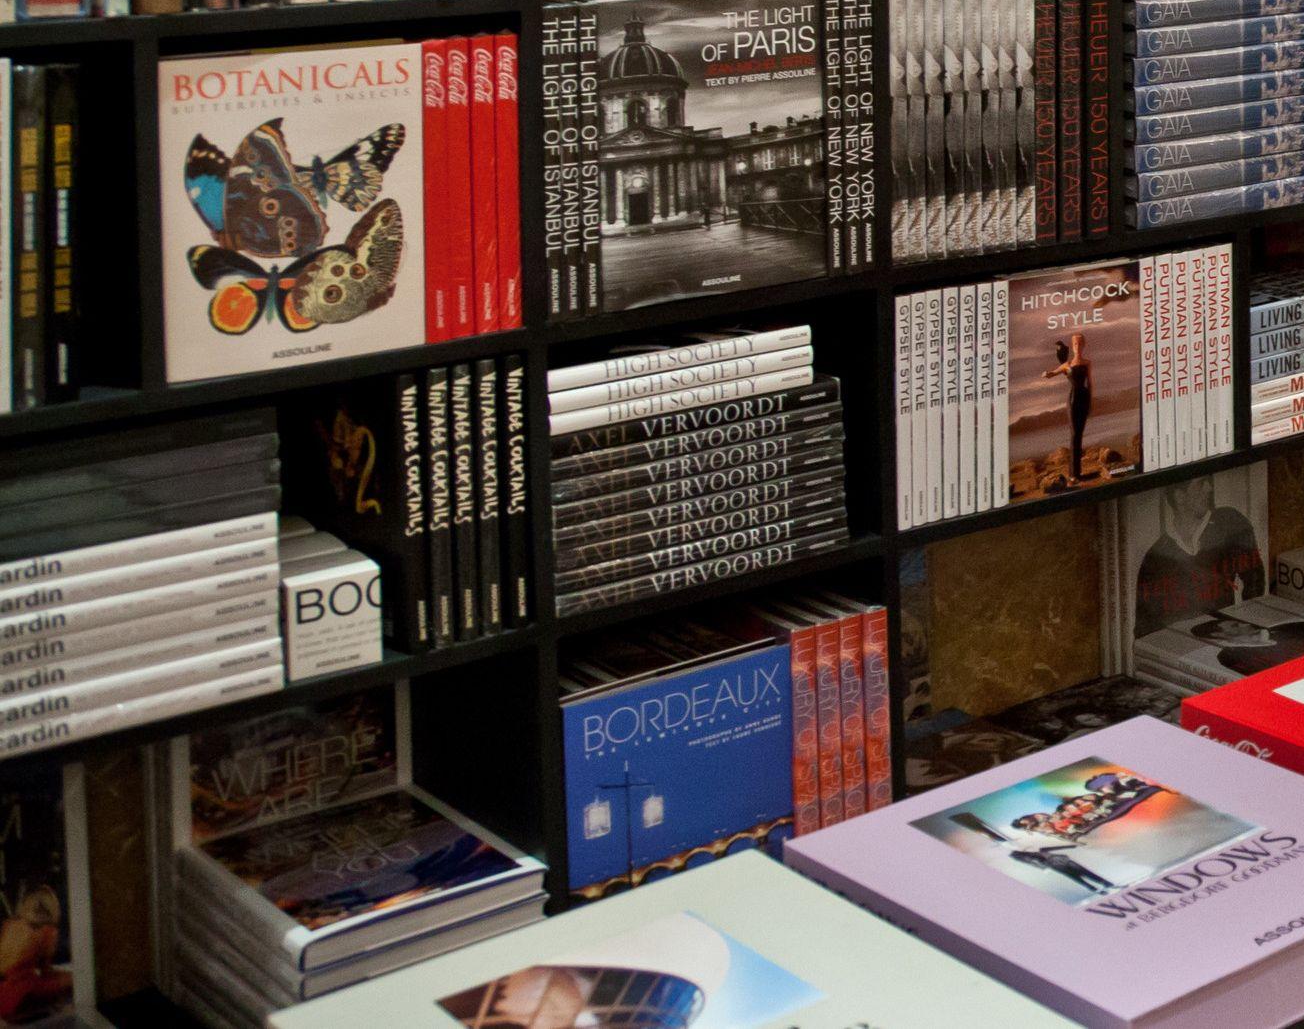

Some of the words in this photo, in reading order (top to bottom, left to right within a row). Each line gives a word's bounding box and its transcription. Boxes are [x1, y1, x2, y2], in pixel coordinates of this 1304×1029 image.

[580, 14, 597, 52] THE
[723, 10, 759, 30] THE
[764, 5, 816, 26] LIGHT
[701, 43, 727, 63] OF
[733, 25, 816, 60] PARIS
[825, 38, 840, 88] LIGHT
[1090, 2, 1109, 83] HEUER
[173, 57, 411, 103] BOTANICALS
[580, 59, 598, 119] LIGHT
[705, 76, 726, 87] TEXT
[727, 76, 740, 86] BY
[741, 71, 771, 84] PIERRE
[772, 67, 817, 82] ASSOULINE
[171, 94, 302, 115] BUTTERFLIES
[312, 94, 323, 105] &
[335, 87, 412, 102] INSECTS
[826, 95, 841, 121] OF
[1090, 95, 1108, 135] 150
[581, 124, 598, 152] OF
[827, 126, 843, 169] NEW
[828, 174, 843, 224] YORK
[1090, 139, 1109, 222] YEARS
[582, 160, 599, 252] ISTANBUL
[1146, 199, 1194, 225] GAIA
[1021, 281, 1131, 311] HITCHCOCK
[1220, 252, 1231, 329] PUTMAN
[947, 295, 957, 354] GYPSET
[1047, 307, 1104, 331] STYLE
[1260, 305, 1302, 329] LIVING
[604, 349, 662, 379] HIGH
[667, 336, 756, 367] SOCIETY
[1220, 334, 1231, 386] STYLE
[506, 367, 524, 433] VINTAGE
[946, 357, 957, 405] STYLE
[640, 393, 788, 438] VERVOORDT
[583, 663, 781, 753] BORDEAUX
[1085, 830, 1298, 921] WINDOWS
